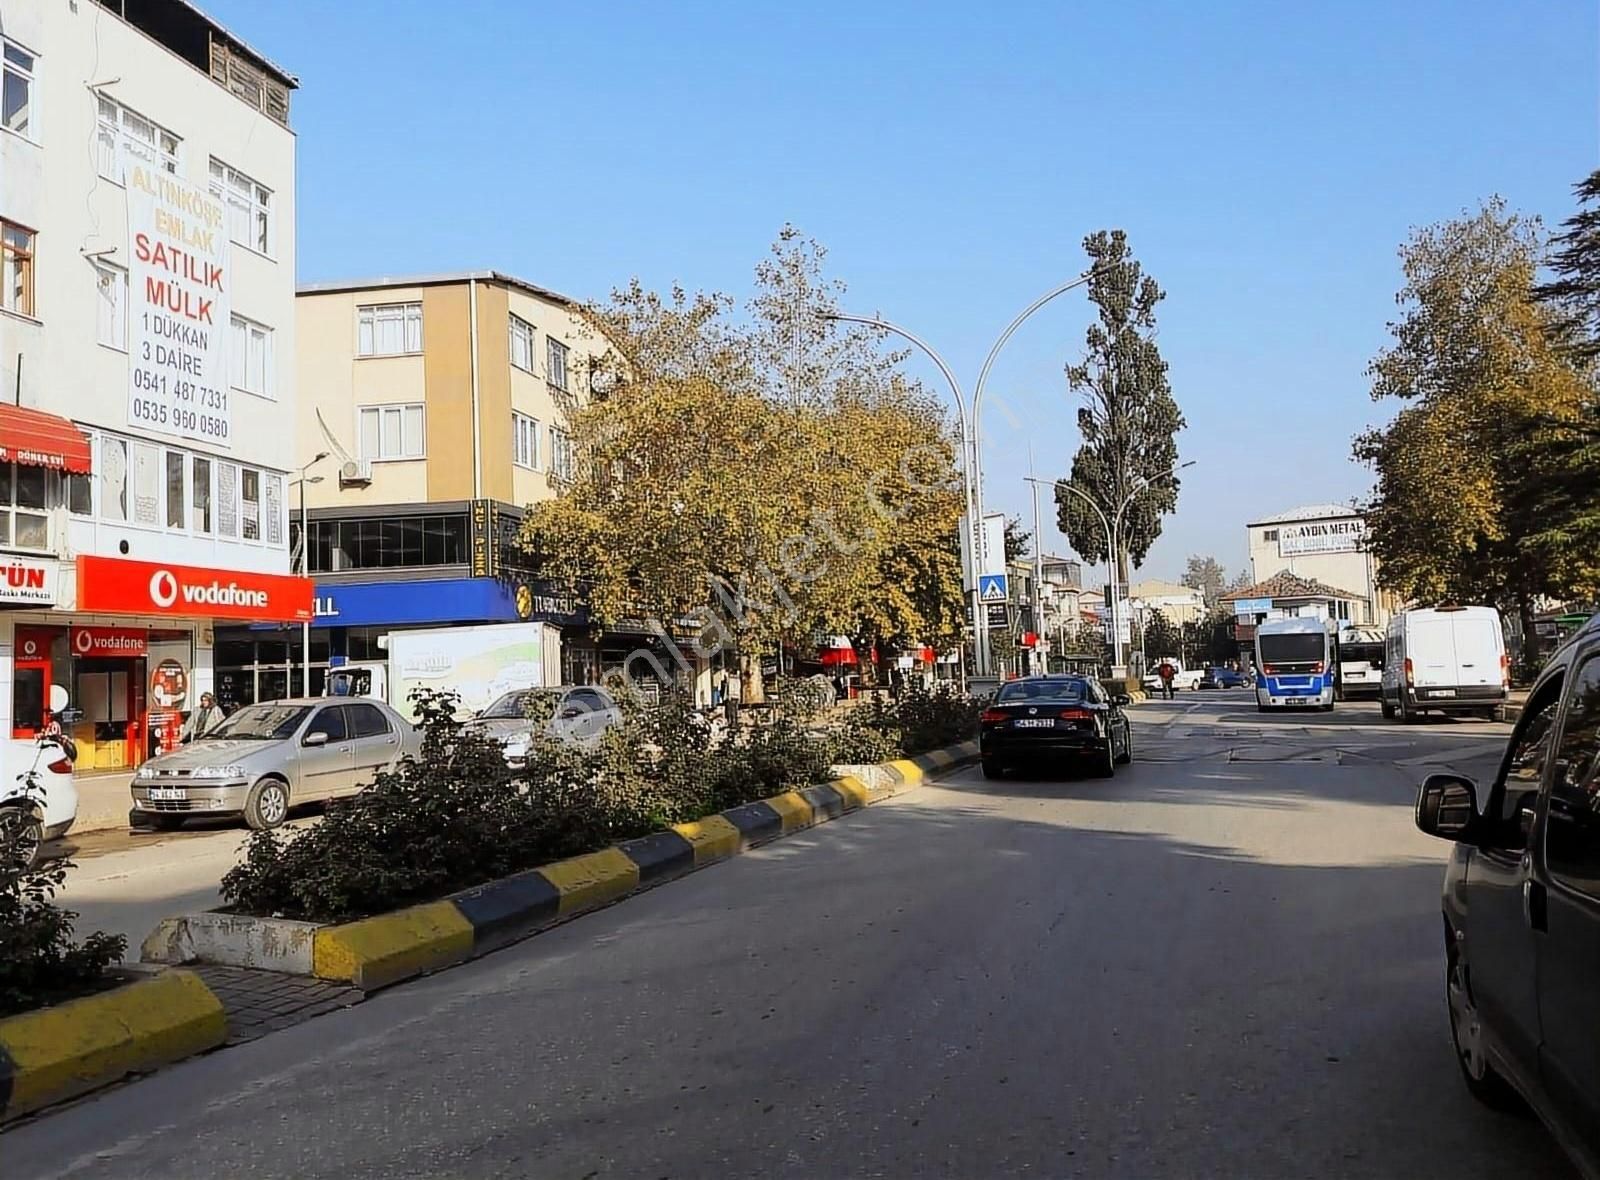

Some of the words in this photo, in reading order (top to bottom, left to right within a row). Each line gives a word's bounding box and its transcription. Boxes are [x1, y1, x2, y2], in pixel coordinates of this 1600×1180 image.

[155, 206, 214, 255] EMLAK
[135, 232, 223, 293] SATILIK
[146, 275, 212, 325] MÜLK
[143, 312, 148, 331] 1
[154, 314, 207, 350] DÜKKAN
[143, 341, 150, 360] 3
[156, 345, 202, 377] DAİRE
[134, 368, 166, 394] 0541
[174, 380, 195, 402] 487
[200, 387, 227, 411] 7331
[133, 398, 167, 424] 0535
[173, 408, 196, 430] 960
[200, 415, 228, 438] 0580
[1299, 525, 1327, 537] AYDIN
[1330, 522, 1361, 535] METAL
[182, 580, 269, 607] vodafone
[94, 634, 144, 650] vodafone
